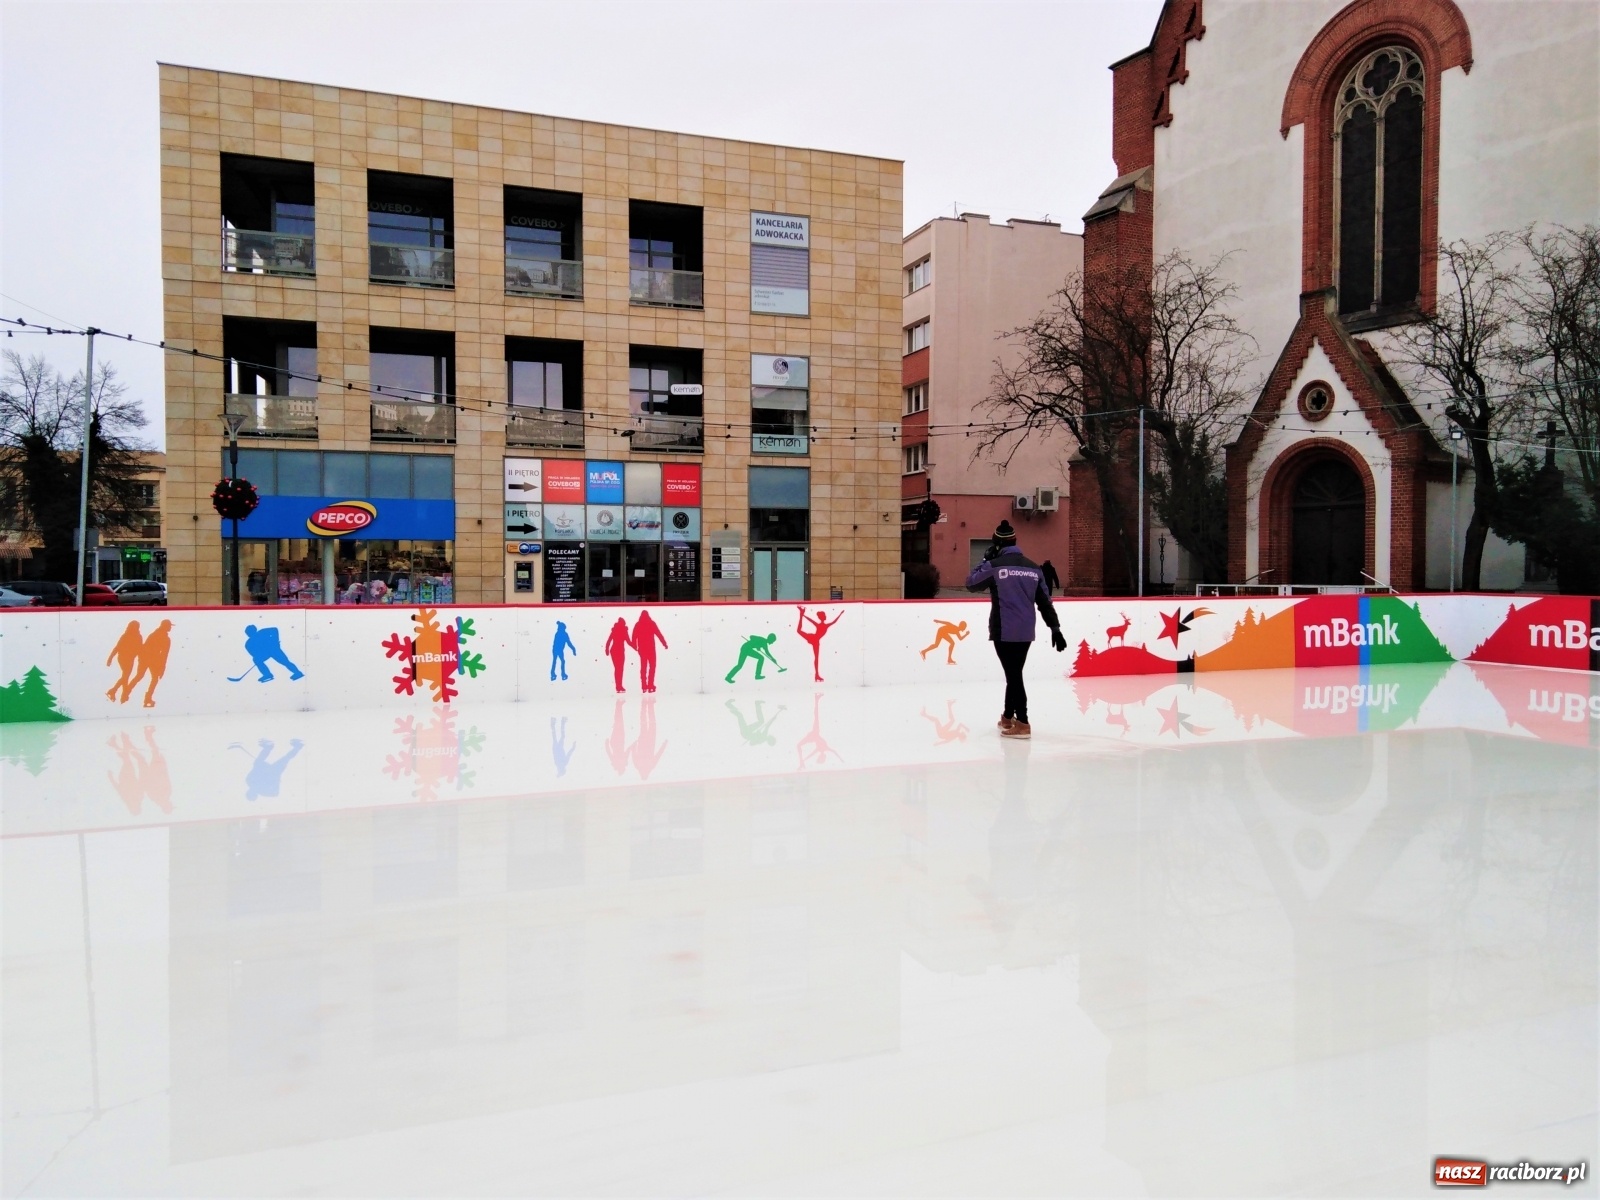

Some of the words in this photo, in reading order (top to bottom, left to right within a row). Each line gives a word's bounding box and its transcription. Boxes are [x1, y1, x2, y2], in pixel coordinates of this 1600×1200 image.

[511, 216, 557, 229] COVEBO
[755, 218, 803, 230] KANCELARIA
[754, 229, 804, 241] ADWOKACKA
[514, 469, 540, 477] PIĘTRO
[317, 512, 366, 524] PEPCO
[511, 510, 540, 518] PIĘTRO
[1009, 570, 1039, 578] LODOWISKA
[1303, 614, 1400, 648] mBank
[412, 651, 458, 663] mBank
